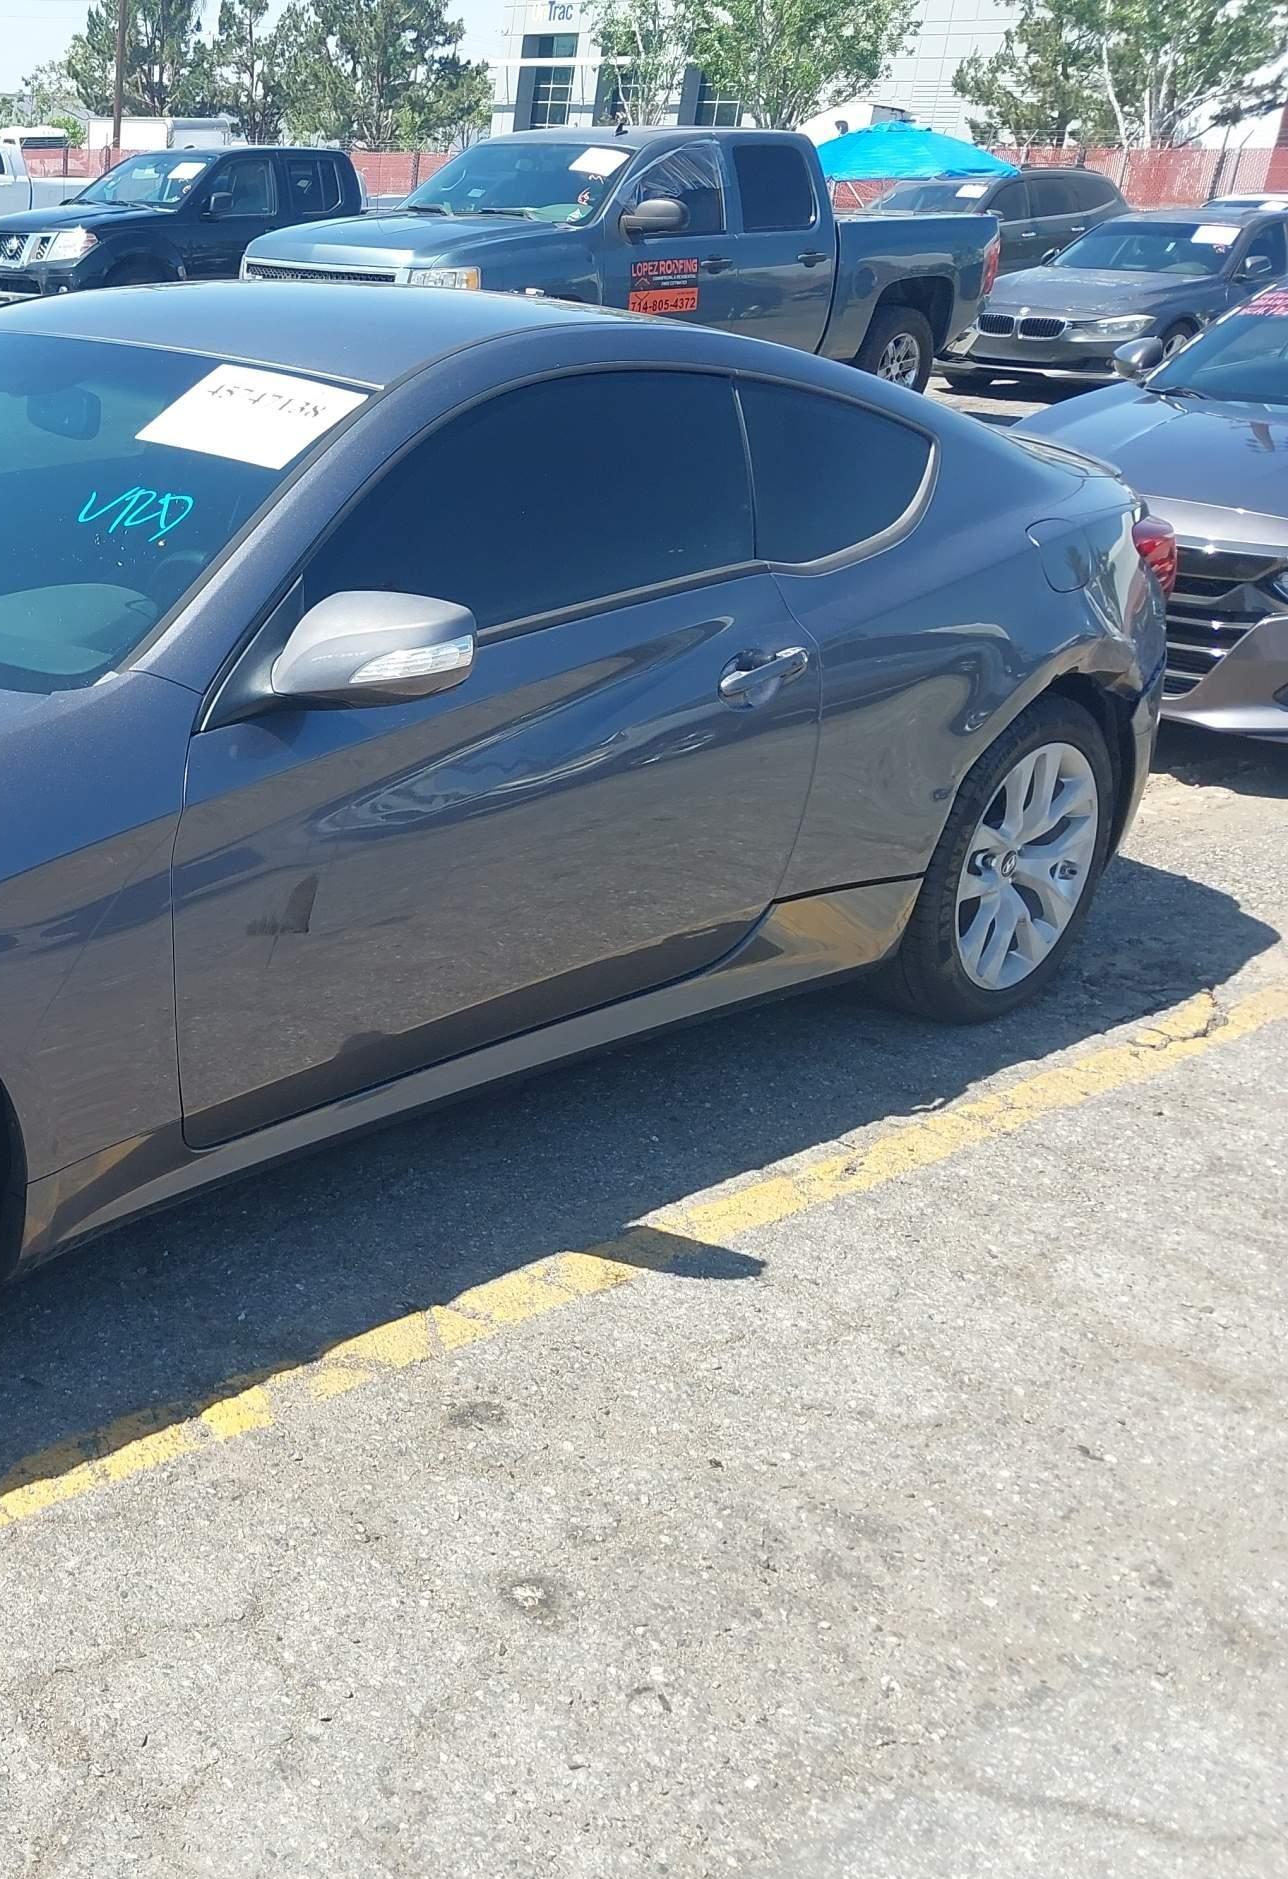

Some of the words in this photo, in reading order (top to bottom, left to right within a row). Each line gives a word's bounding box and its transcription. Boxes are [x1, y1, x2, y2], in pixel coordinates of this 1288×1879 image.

[632, 261, 659, 277] LOPEZ
[659, 259, 698, 274] ROOFING
[631, 297, 696, 312] 714-805-4372
